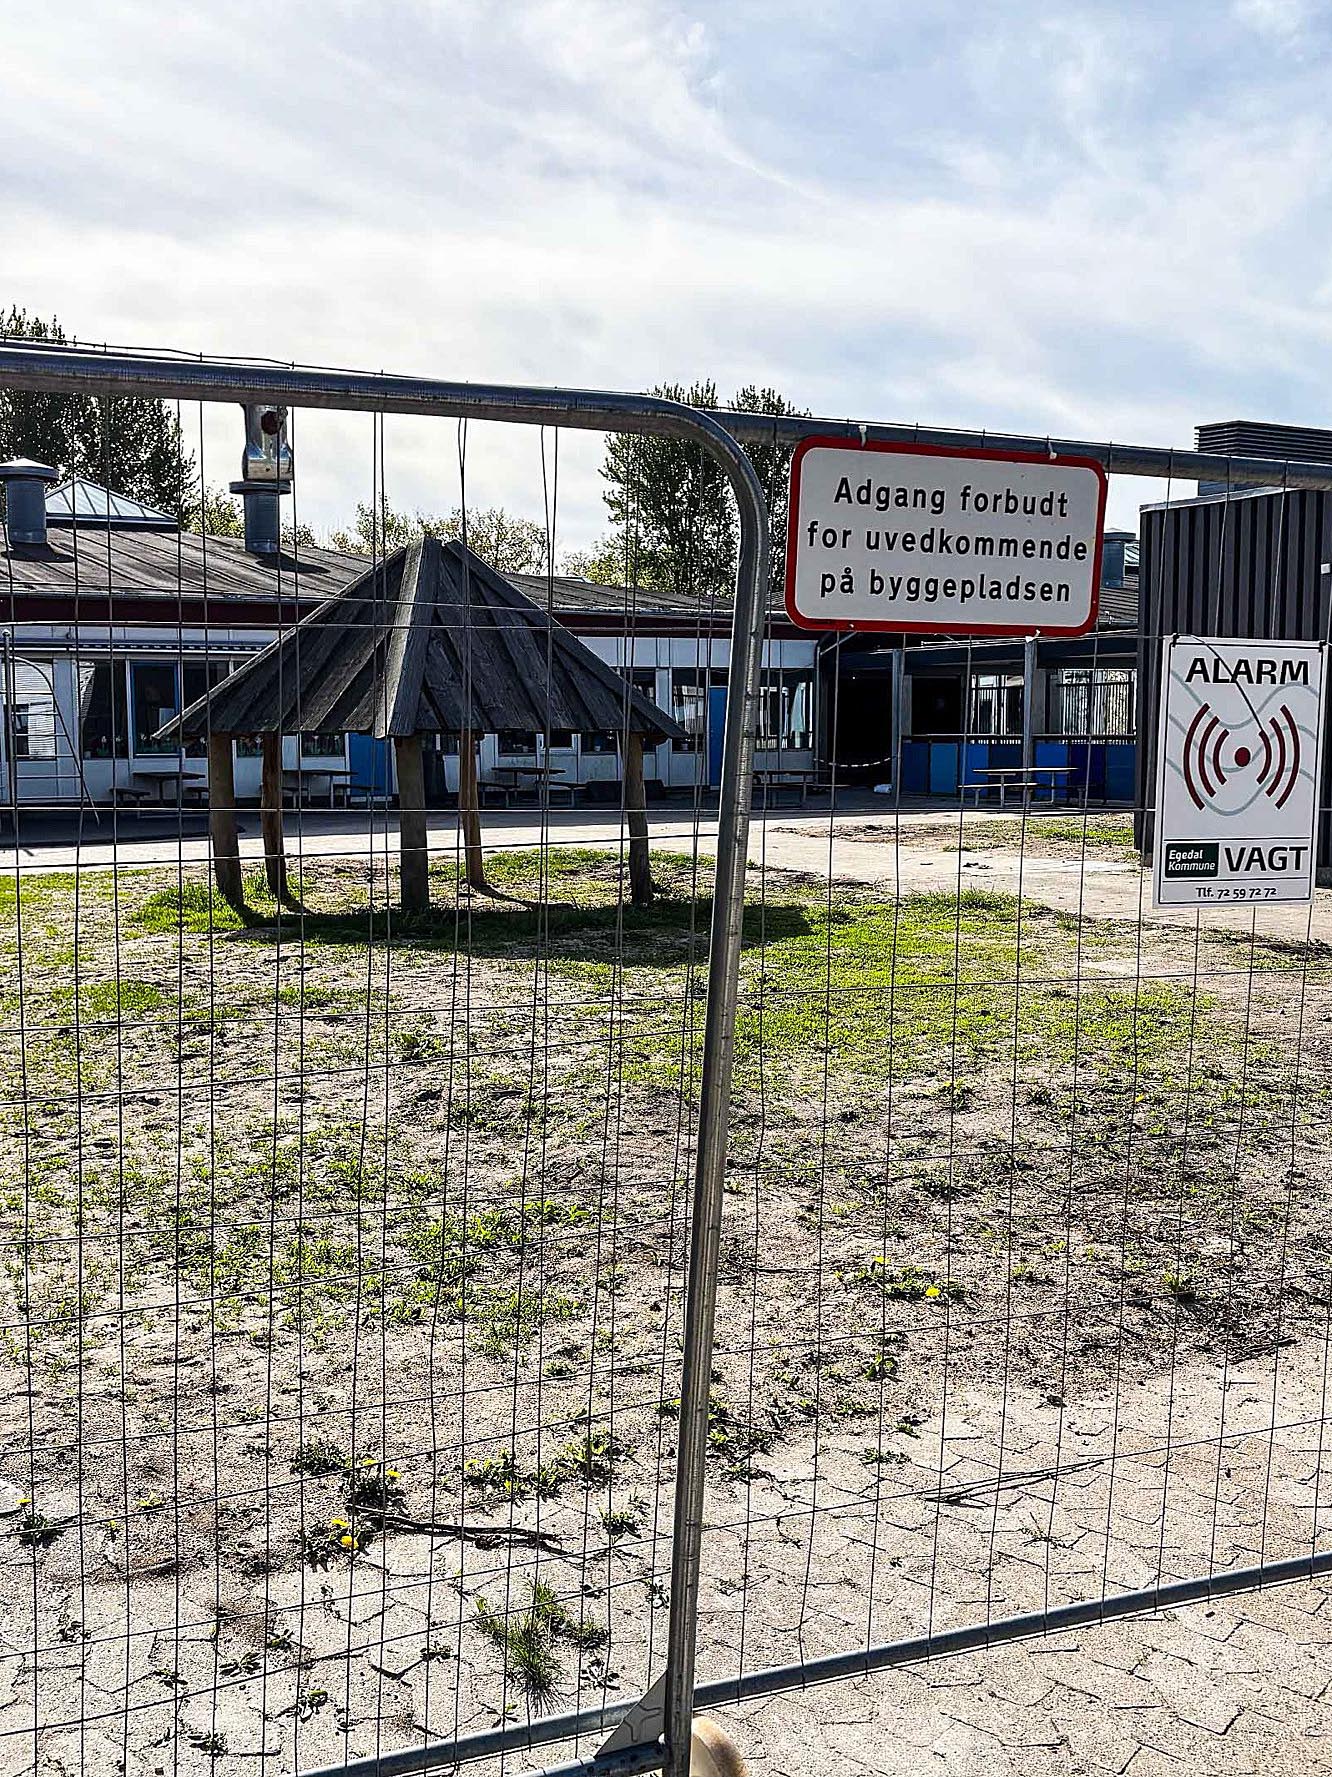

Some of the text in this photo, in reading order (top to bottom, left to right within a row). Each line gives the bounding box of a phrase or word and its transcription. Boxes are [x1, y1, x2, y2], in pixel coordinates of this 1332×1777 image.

[833, 477, 1068, 517] Adgang forbudt
[807, 521, 1088, 560] for uvedkommende
[820, 567, 1070, 603] på byggepladsen
[1185, 657, 1309, 685] ALARM
[1168, 850, 1203, 861] Egedal
[1168, 860, 1215, 872] Kommune
[1224, 846, 1308, 871] VAGT
[1196, 887, 1277, 898] Tlf. 72 59 72 72
